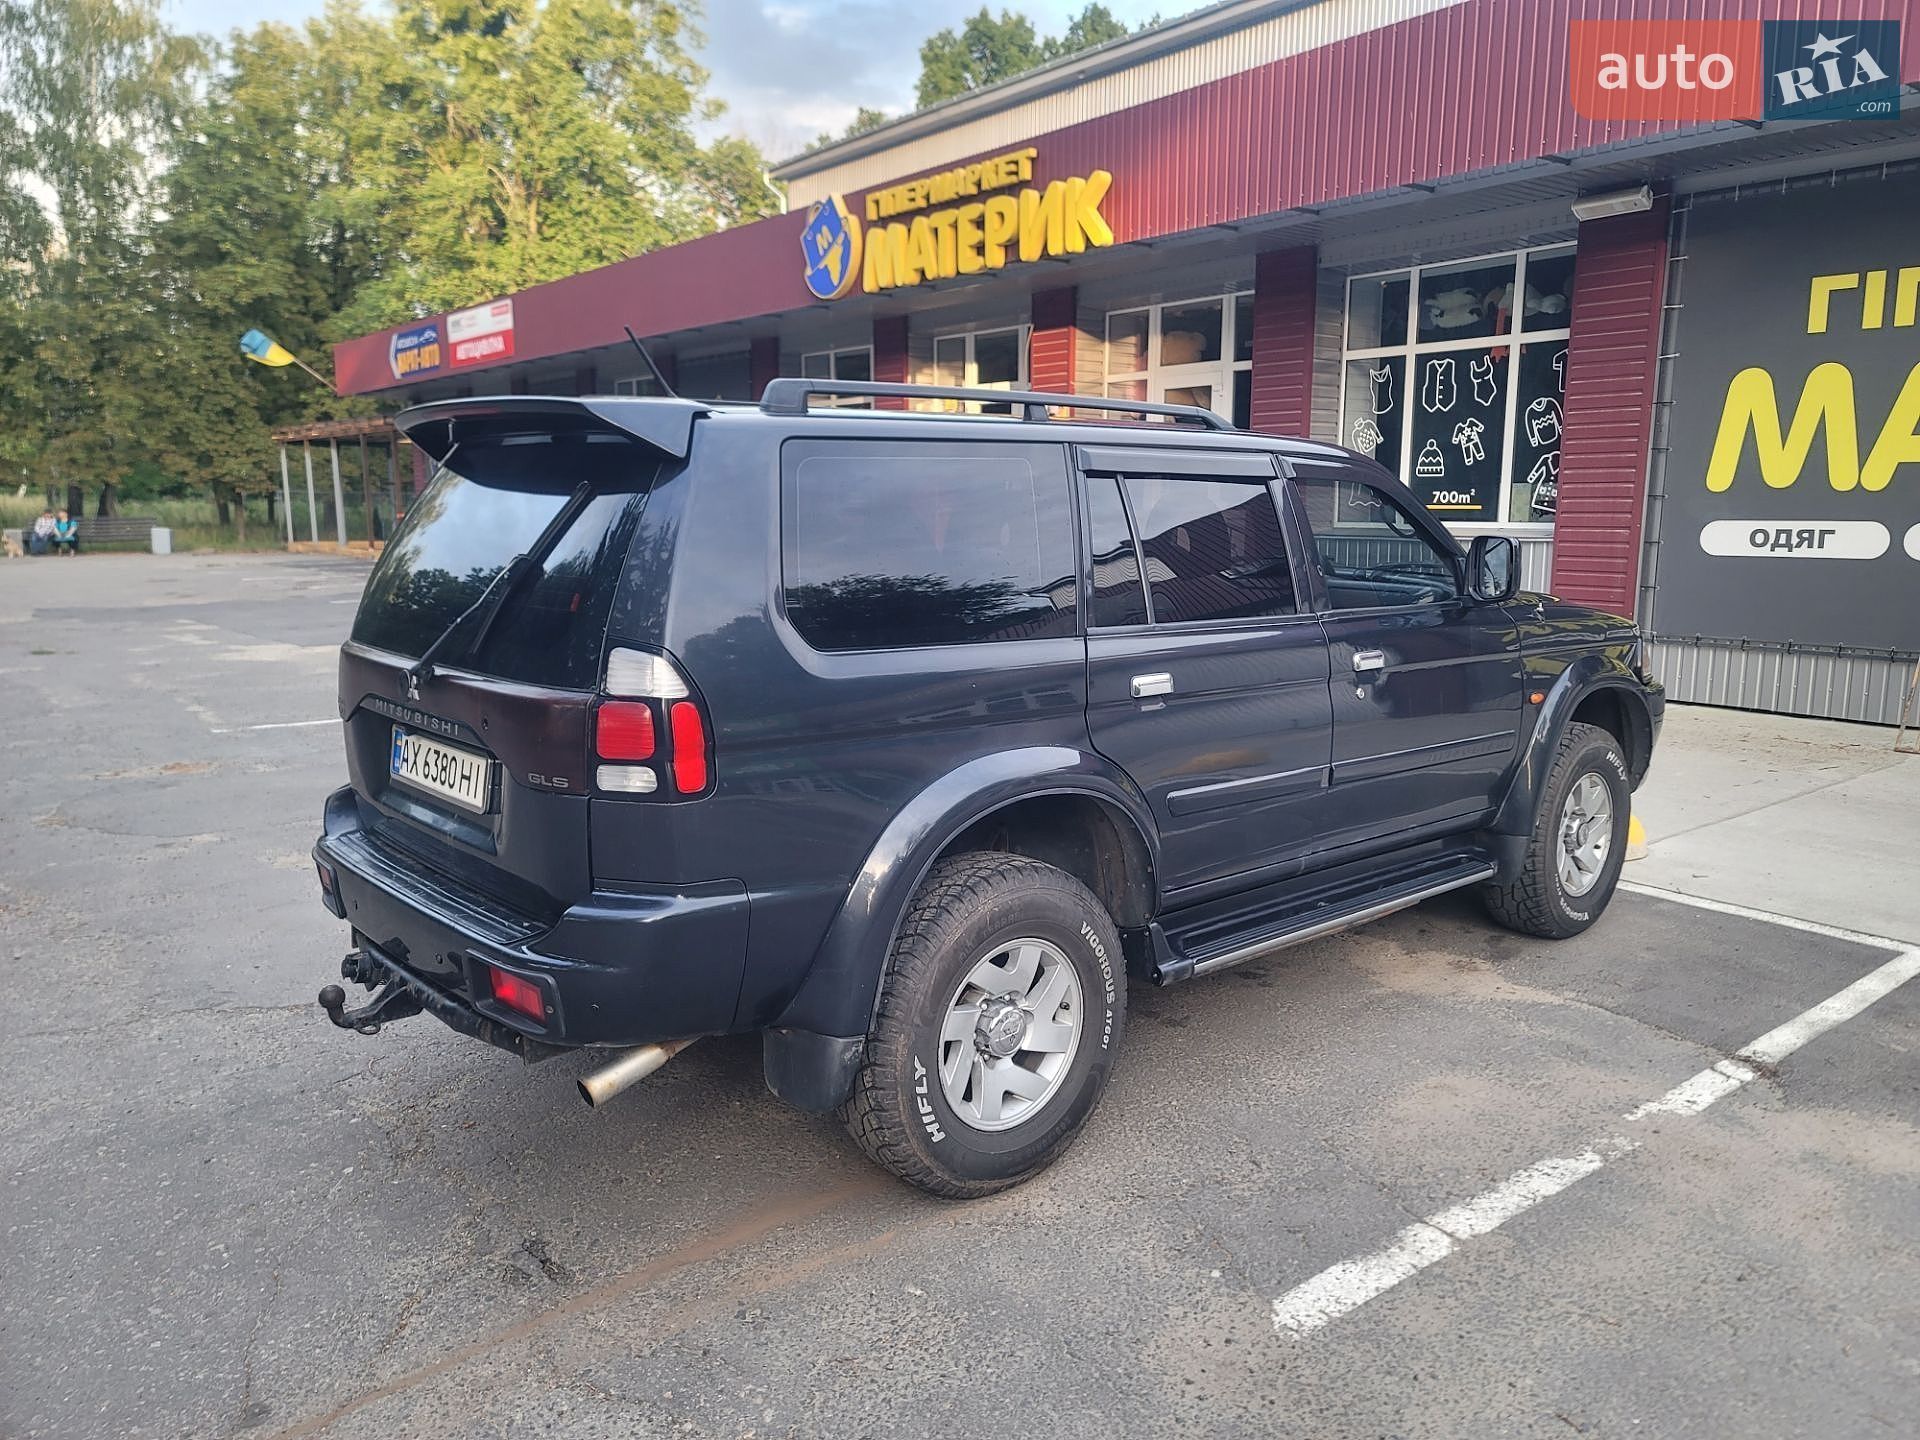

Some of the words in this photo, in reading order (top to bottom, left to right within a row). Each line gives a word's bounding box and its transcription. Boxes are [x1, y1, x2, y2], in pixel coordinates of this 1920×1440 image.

[865, 147, 1039, 221] ГІПЕРМАРКЕТ
[862, 169, 1115, 293] МАТЕРИК
[1748, 526, 1836, 553] ОДЯГ
[374, 699, 460, 737] MITSUBISHI
[423, 747, 458, 790] 6380
[527, 772, 569, 789] GLS
[1606, 751, 1628, 781] HIFLY
[1079, 920, 1116, 1005] VIGOROUS
[913, 1055, 947, 1144] HIFLY
